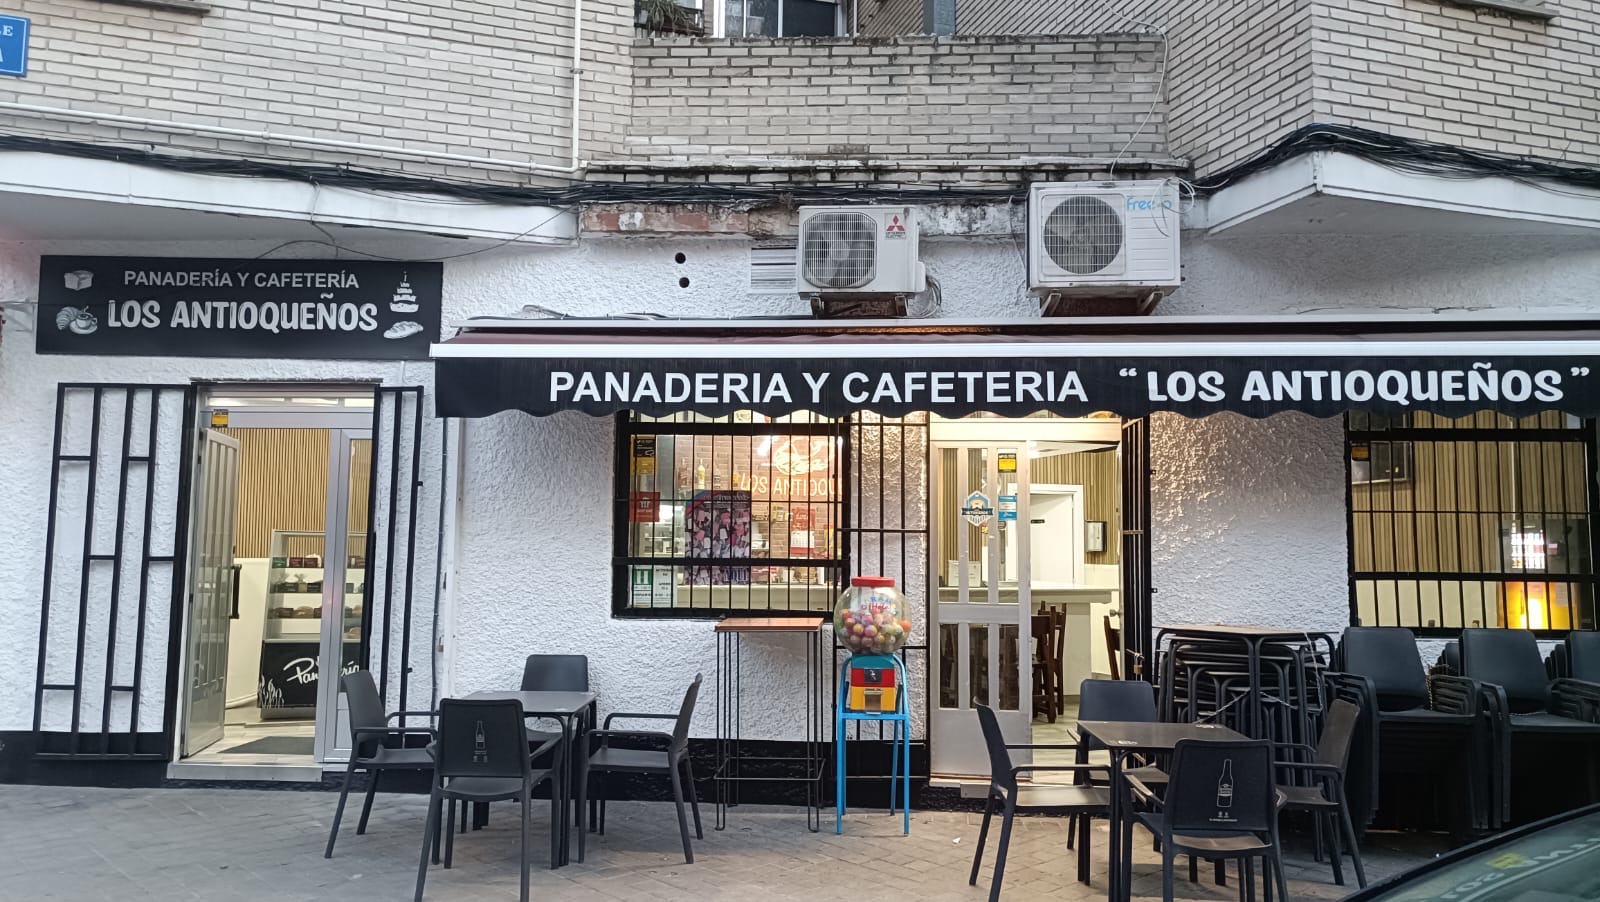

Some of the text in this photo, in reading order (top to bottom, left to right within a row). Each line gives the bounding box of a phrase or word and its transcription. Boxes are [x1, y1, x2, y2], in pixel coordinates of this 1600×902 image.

[124, 268, 360, 289] PANADERÍA Y CAFETERÍA
[107, 292, 378, 334] LOS ANTIOQUEÑOS
[549, 371, 793, 404] PANADERIA
[803, 372, 831, 403] Y
[842, 370, 1089, 404] CAFETERIA
[740, 473, 768, 494] LOS
